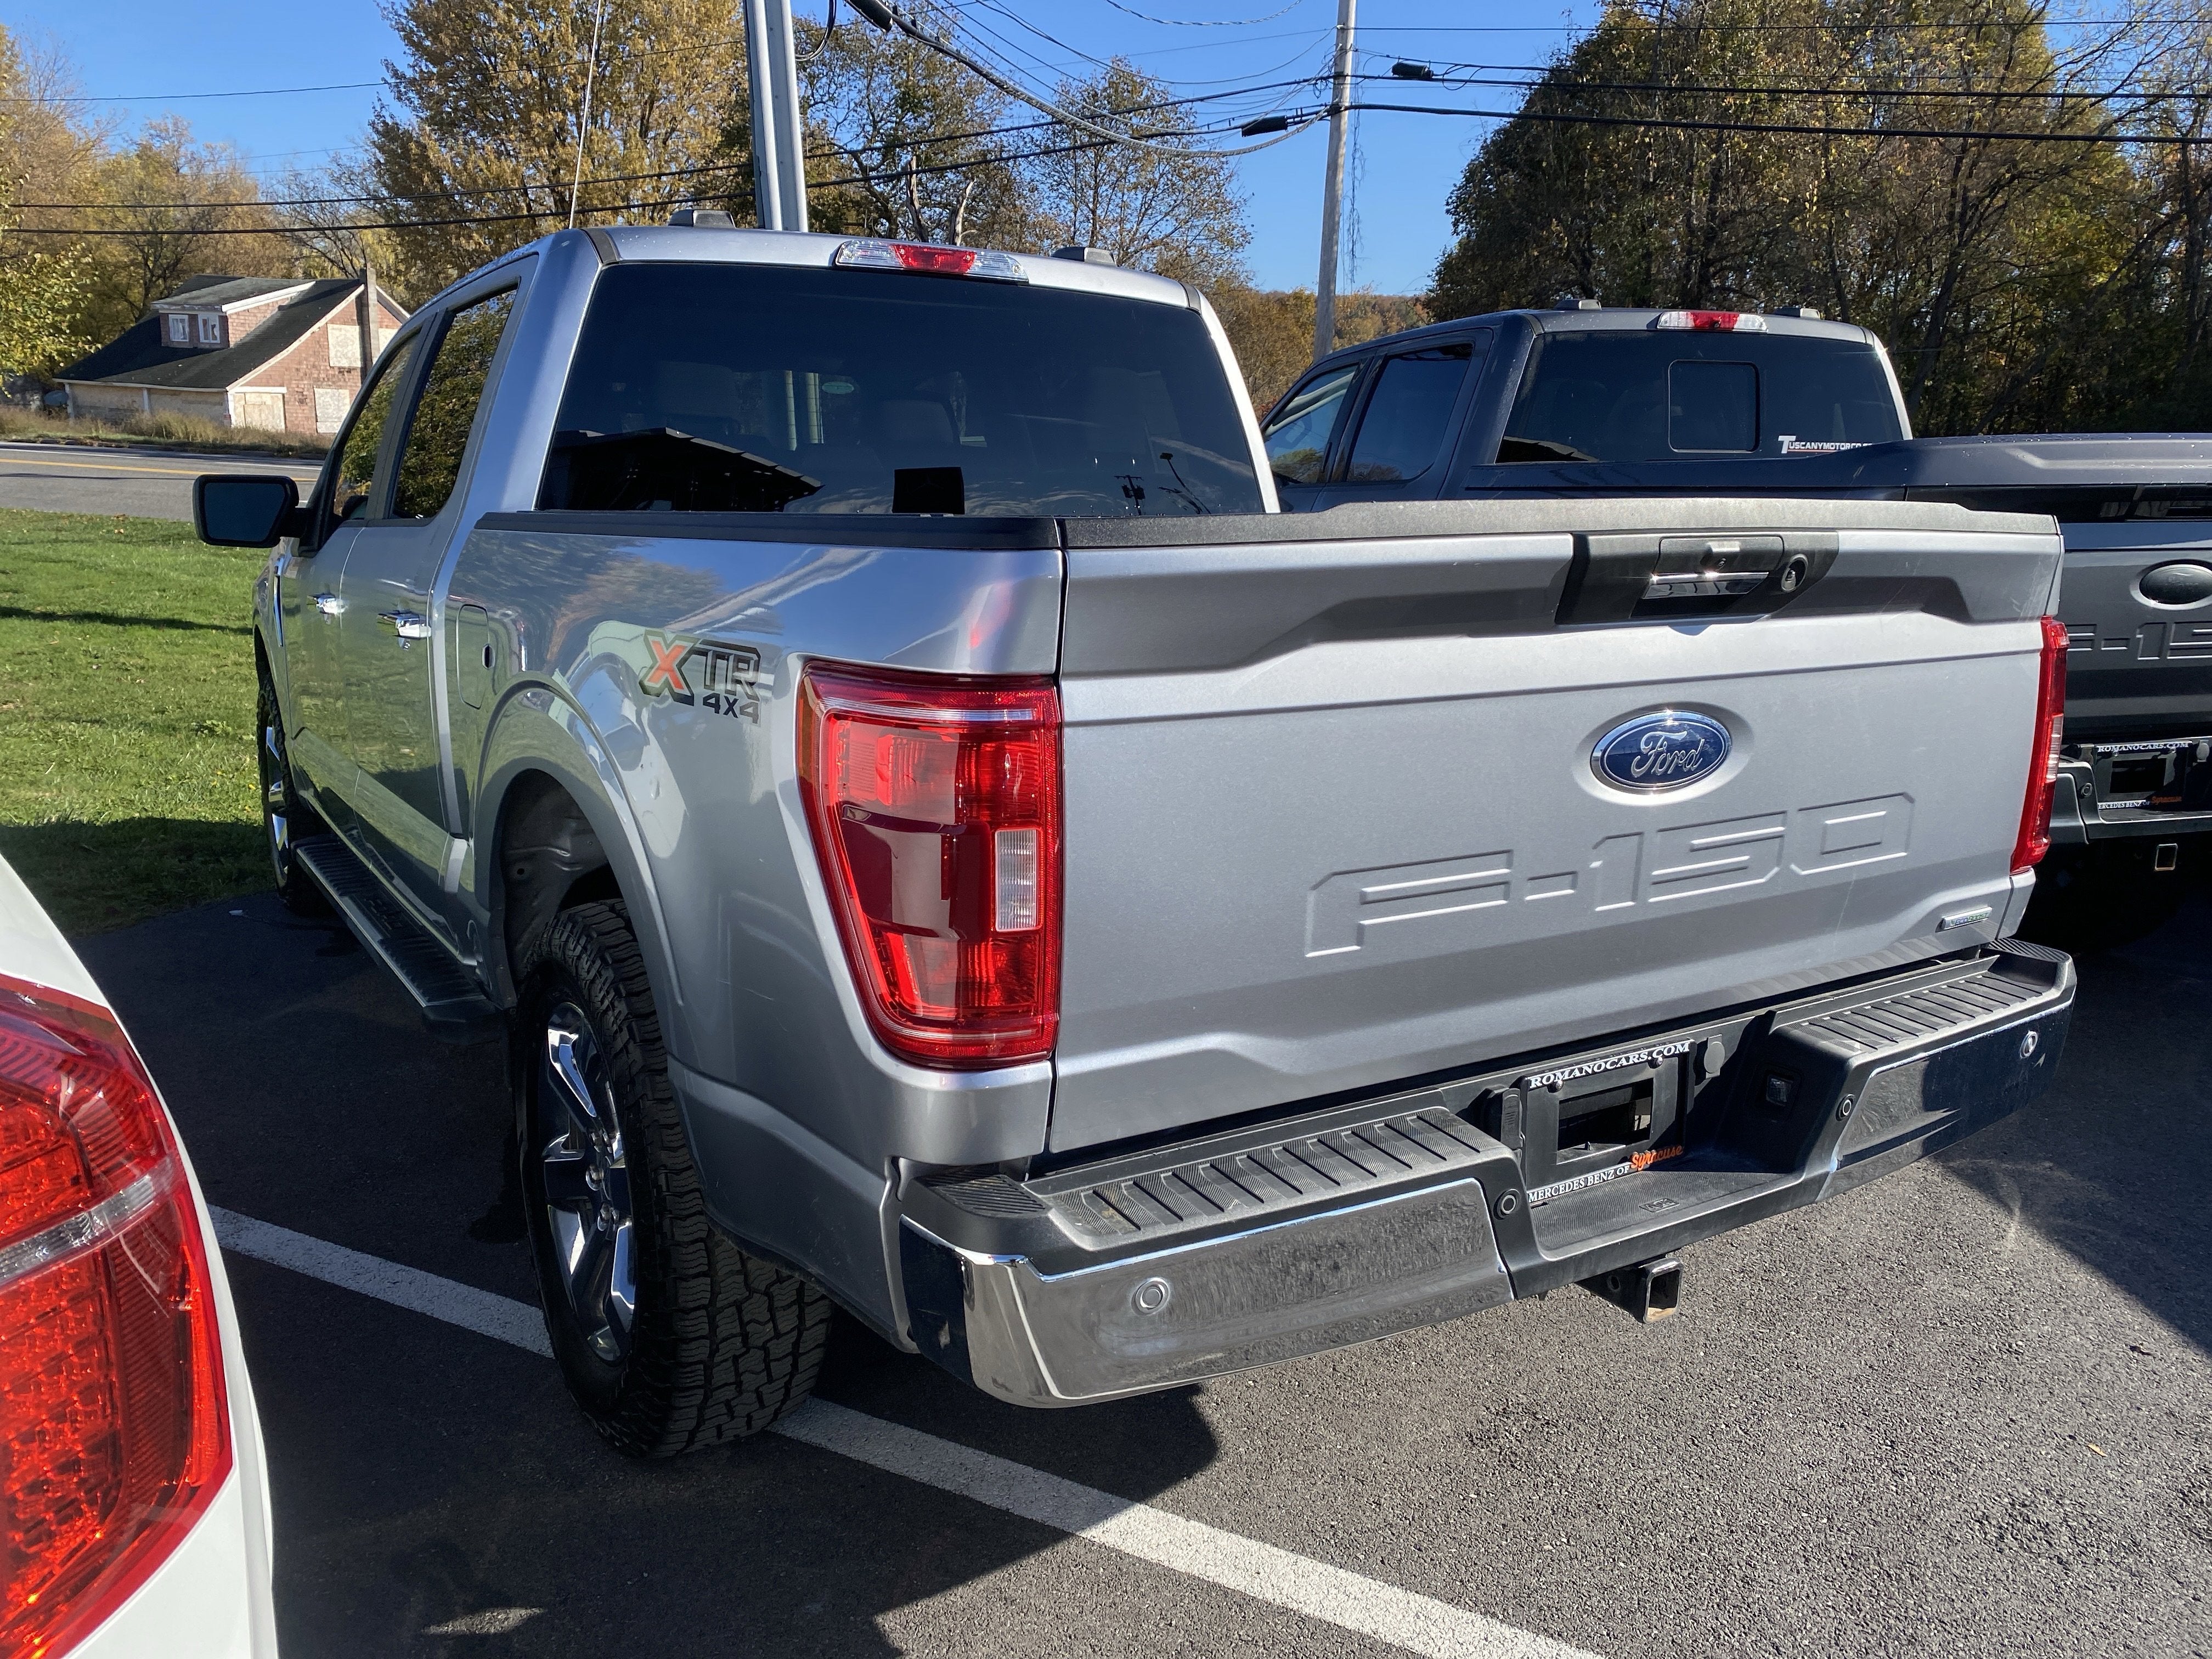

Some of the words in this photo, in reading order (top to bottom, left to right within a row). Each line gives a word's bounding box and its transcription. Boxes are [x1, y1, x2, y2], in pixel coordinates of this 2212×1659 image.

[639, 629, 761, 707] XTR
[1631, 730, 1705, 778] Ford
[2098, 742, 2189, 753] ROMANOCARS.COM
[1306, 792, 1914, 957] F-150
[1529, 1042, 1690, 1088] ROMANOCARS.COM
[1528, 1178, 1585, 1203] MERCEDES
[1587, 1169, 1615, 1185] BENZ
[1616, 1164, 1631, 1175] OF
[1630, 1144, 1683, 1171] Syracuse
